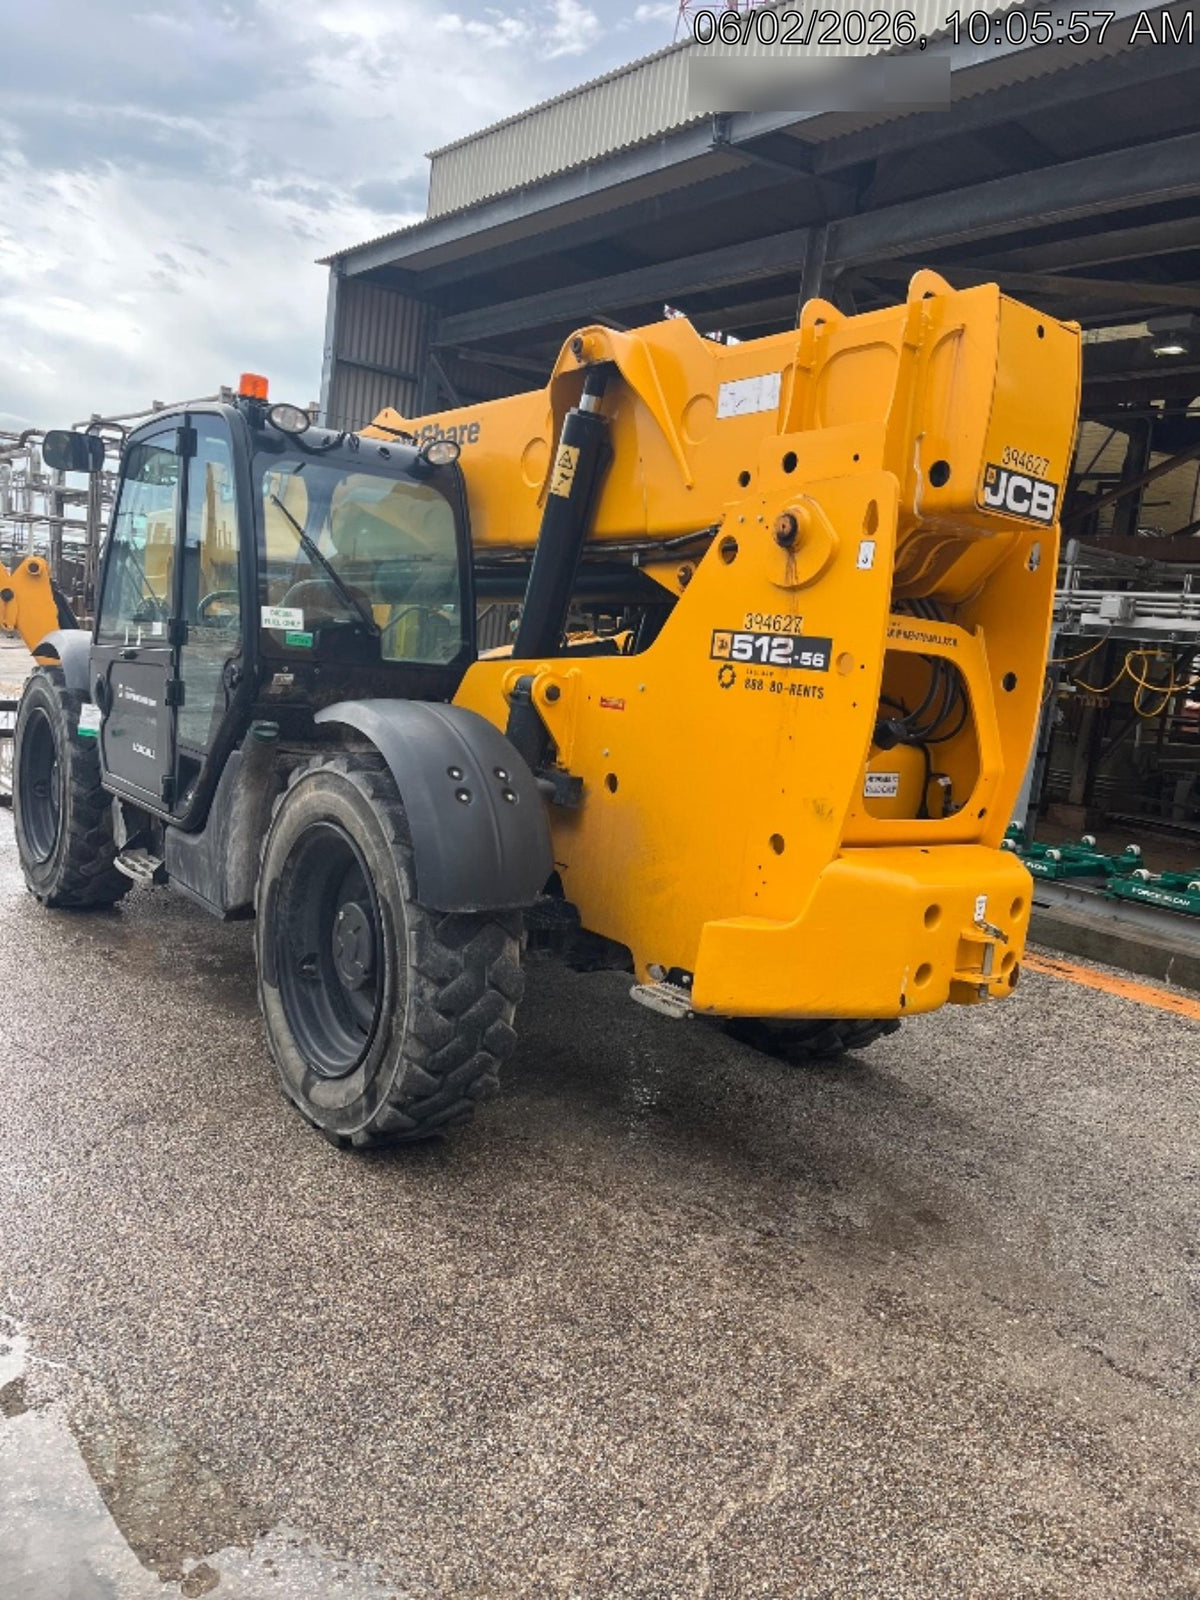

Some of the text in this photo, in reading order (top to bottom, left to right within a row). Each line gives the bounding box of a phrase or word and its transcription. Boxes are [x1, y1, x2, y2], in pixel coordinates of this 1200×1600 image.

[1002, 446, 1050, 477] 394627
[984, 470, 1056, 520] JCB
[744, 612, 803, 633] 394627
